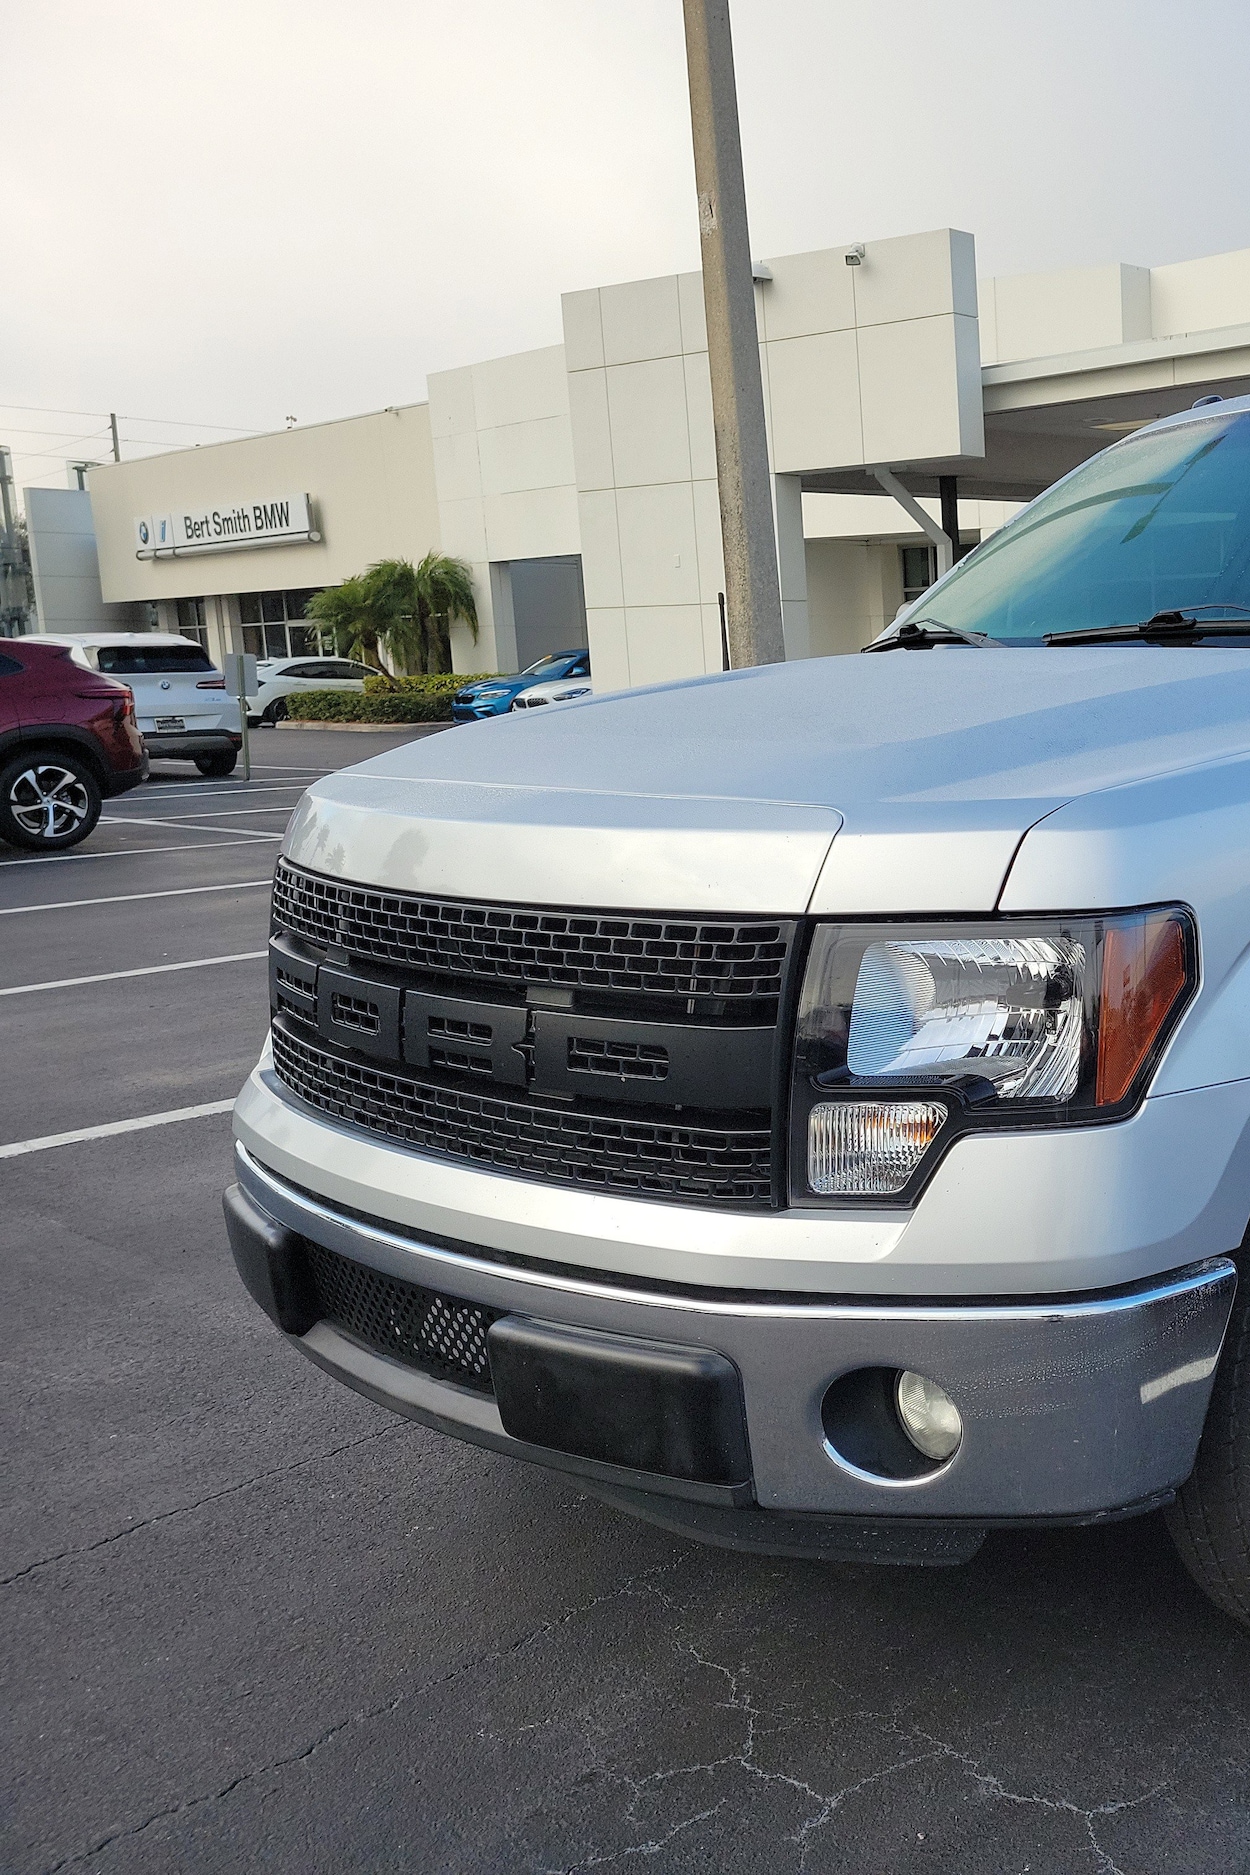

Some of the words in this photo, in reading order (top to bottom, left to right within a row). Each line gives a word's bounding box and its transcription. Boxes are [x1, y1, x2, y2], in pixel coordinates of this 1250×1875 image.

[184, 516, 212, 539] Bert
[212, 508, 251, 536] Smith
[253, 501, 289, 531] BMW
